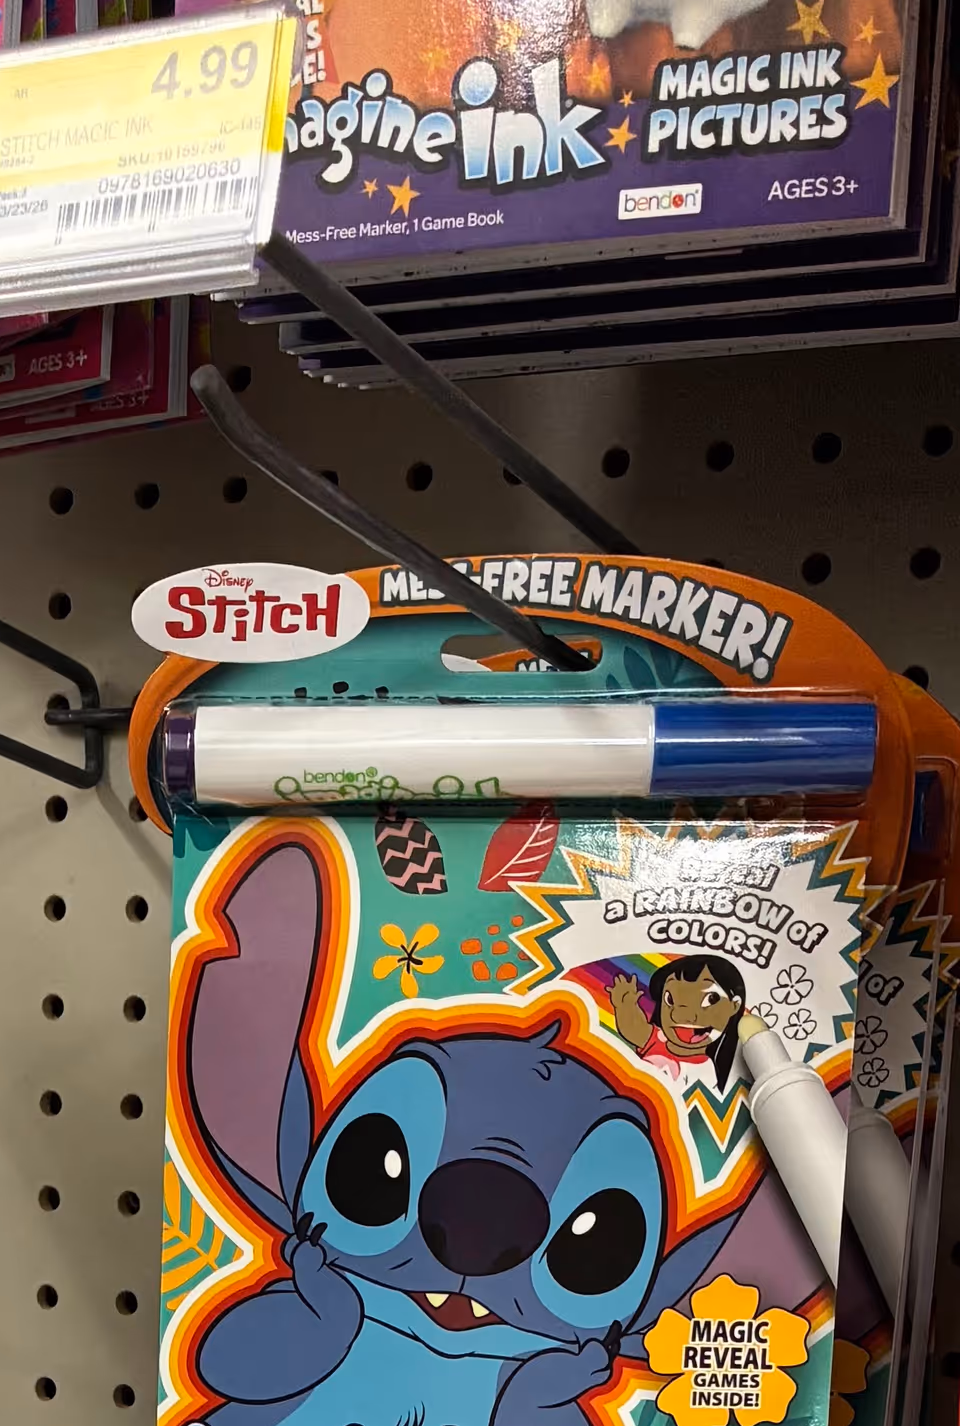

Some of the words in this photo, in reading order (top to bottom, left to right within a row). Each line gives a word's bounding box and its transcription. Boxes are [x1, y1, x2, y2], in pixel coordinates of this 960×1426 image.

[151, 40, 259, 100] 4.99
[659, 54, 771, 100] MAGIC
[779, 48, 842, 90] INK
[1, 131, 58, 157] STITCH
[126, 116, 154, 136] INK
[284, 72, 456, 183] agine
[459, 57, 607, 185] ink
[647, 93, 847, 153] PICTURES
[99, 158, 240, 194] 0978169020630
[768, 178, 828, 200] AGES
[831, 176, 859, 195] 3+
[624, 189, 699, 213] bendon
[285, 225, 356, 245] Mess-Free
[359, 220, 410, 238] Marker,
[421, 215, 465, 231] Game
[467, 210, 504, 227] Book
[581, 565, 789, 681] MARKER!
[633, 885, 794, 934] RAINBOW
[787, 920, 829, 953] of
[647, 919, 777, 968] COLORS!
[691, 1320, 769, 1345] MAGIC
[683, 1346, 774, 1370] REVEAL
[691, 1392, 760, 1408] INSIDE!
[693, 1373, 760, 1389] GAMES
